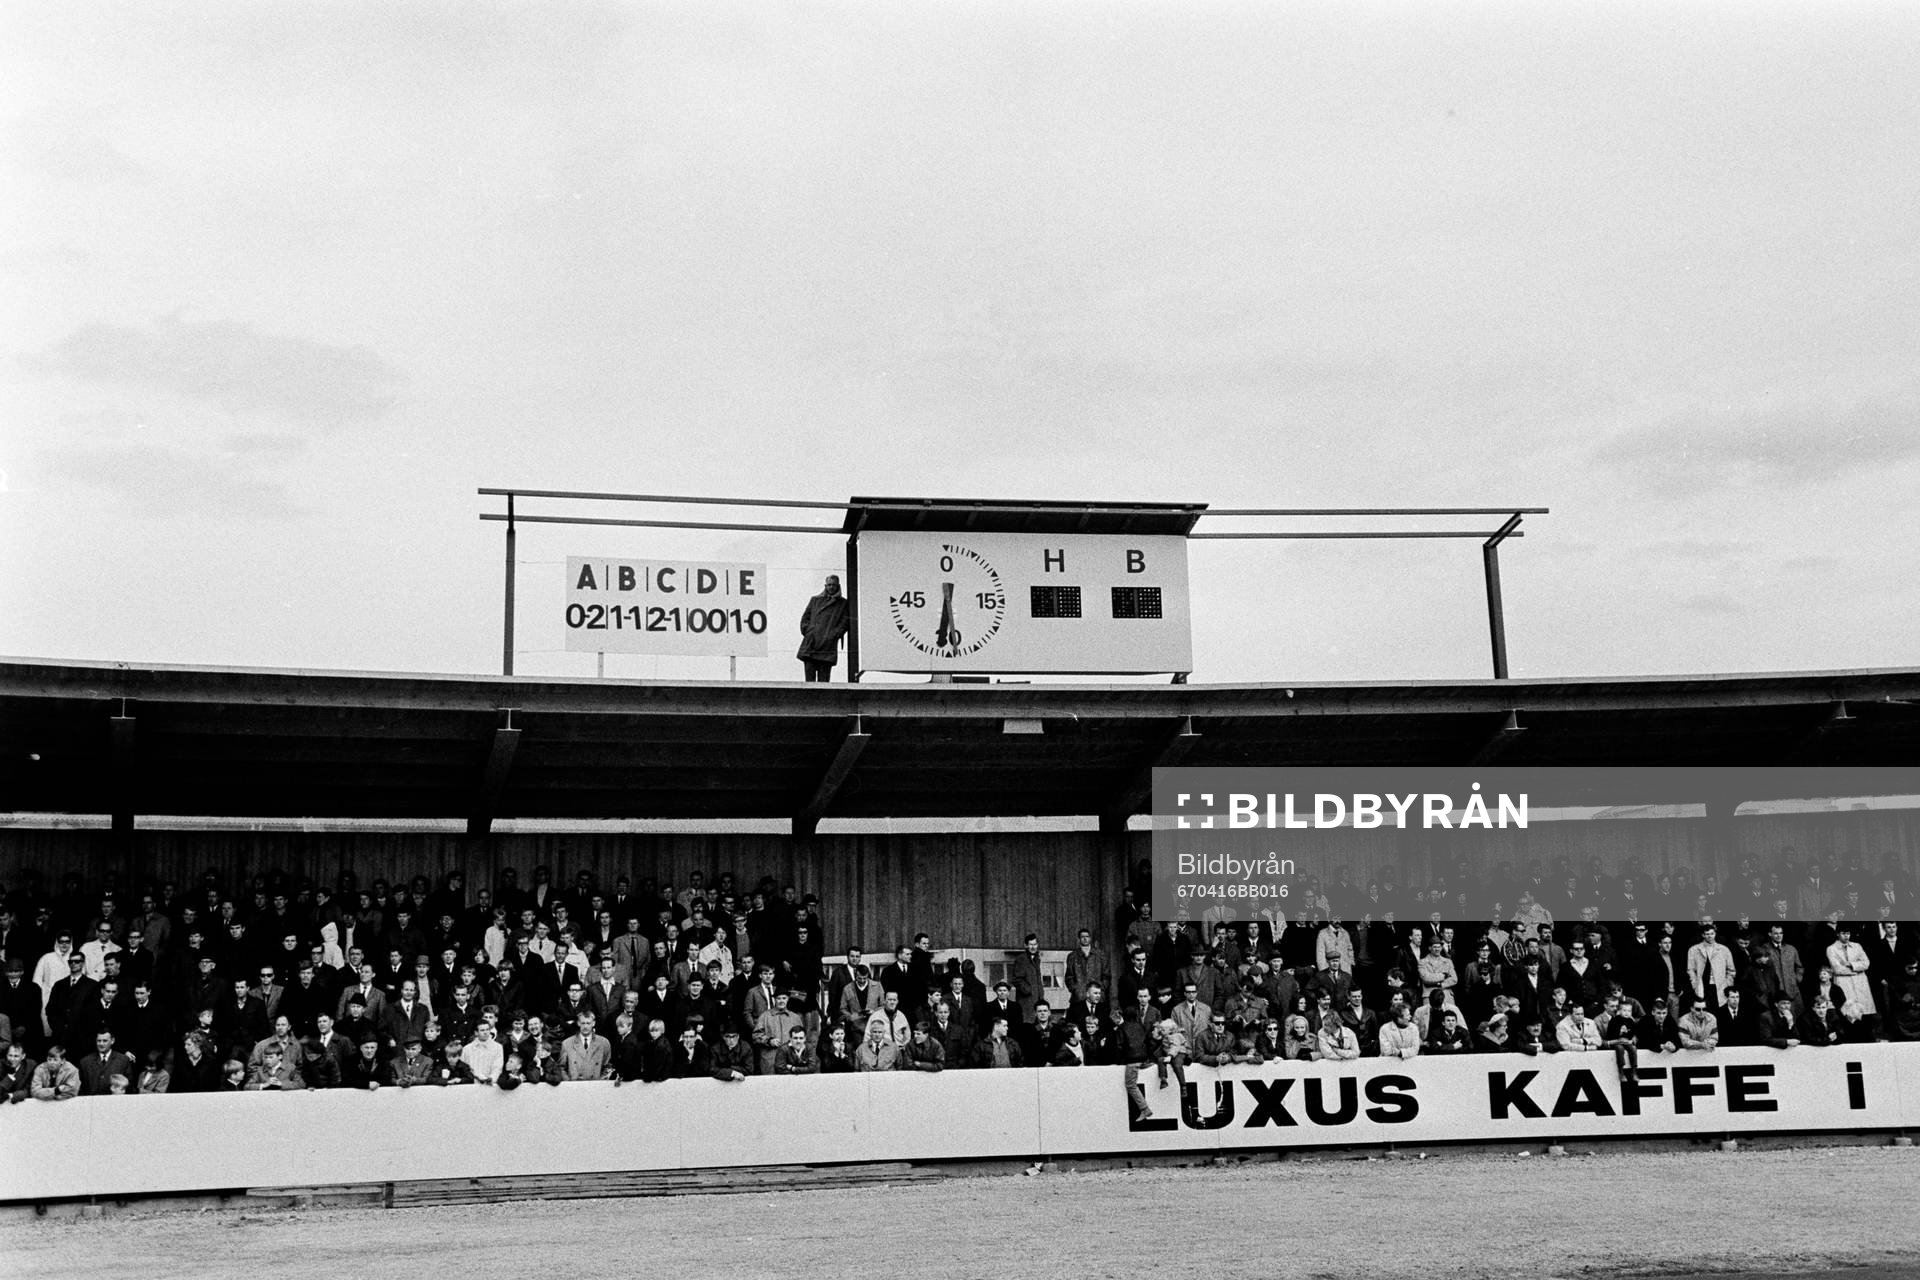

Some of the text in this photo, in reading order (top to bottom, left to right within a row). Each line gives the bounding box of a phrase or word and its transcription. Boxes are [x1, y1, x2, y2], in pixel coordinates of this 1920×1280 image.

[939, 555, 954, 573] 0
[1043, 549, 1065, 573] H
[1126, 549, 1146, 574] B
[576, 563, 755, 596] A B C D E
[898, 590, 926, 609] 45
[975, 592, 997, 610] 15
[1128, 1061, 1867, 1133] LUXUS KAFFE i
